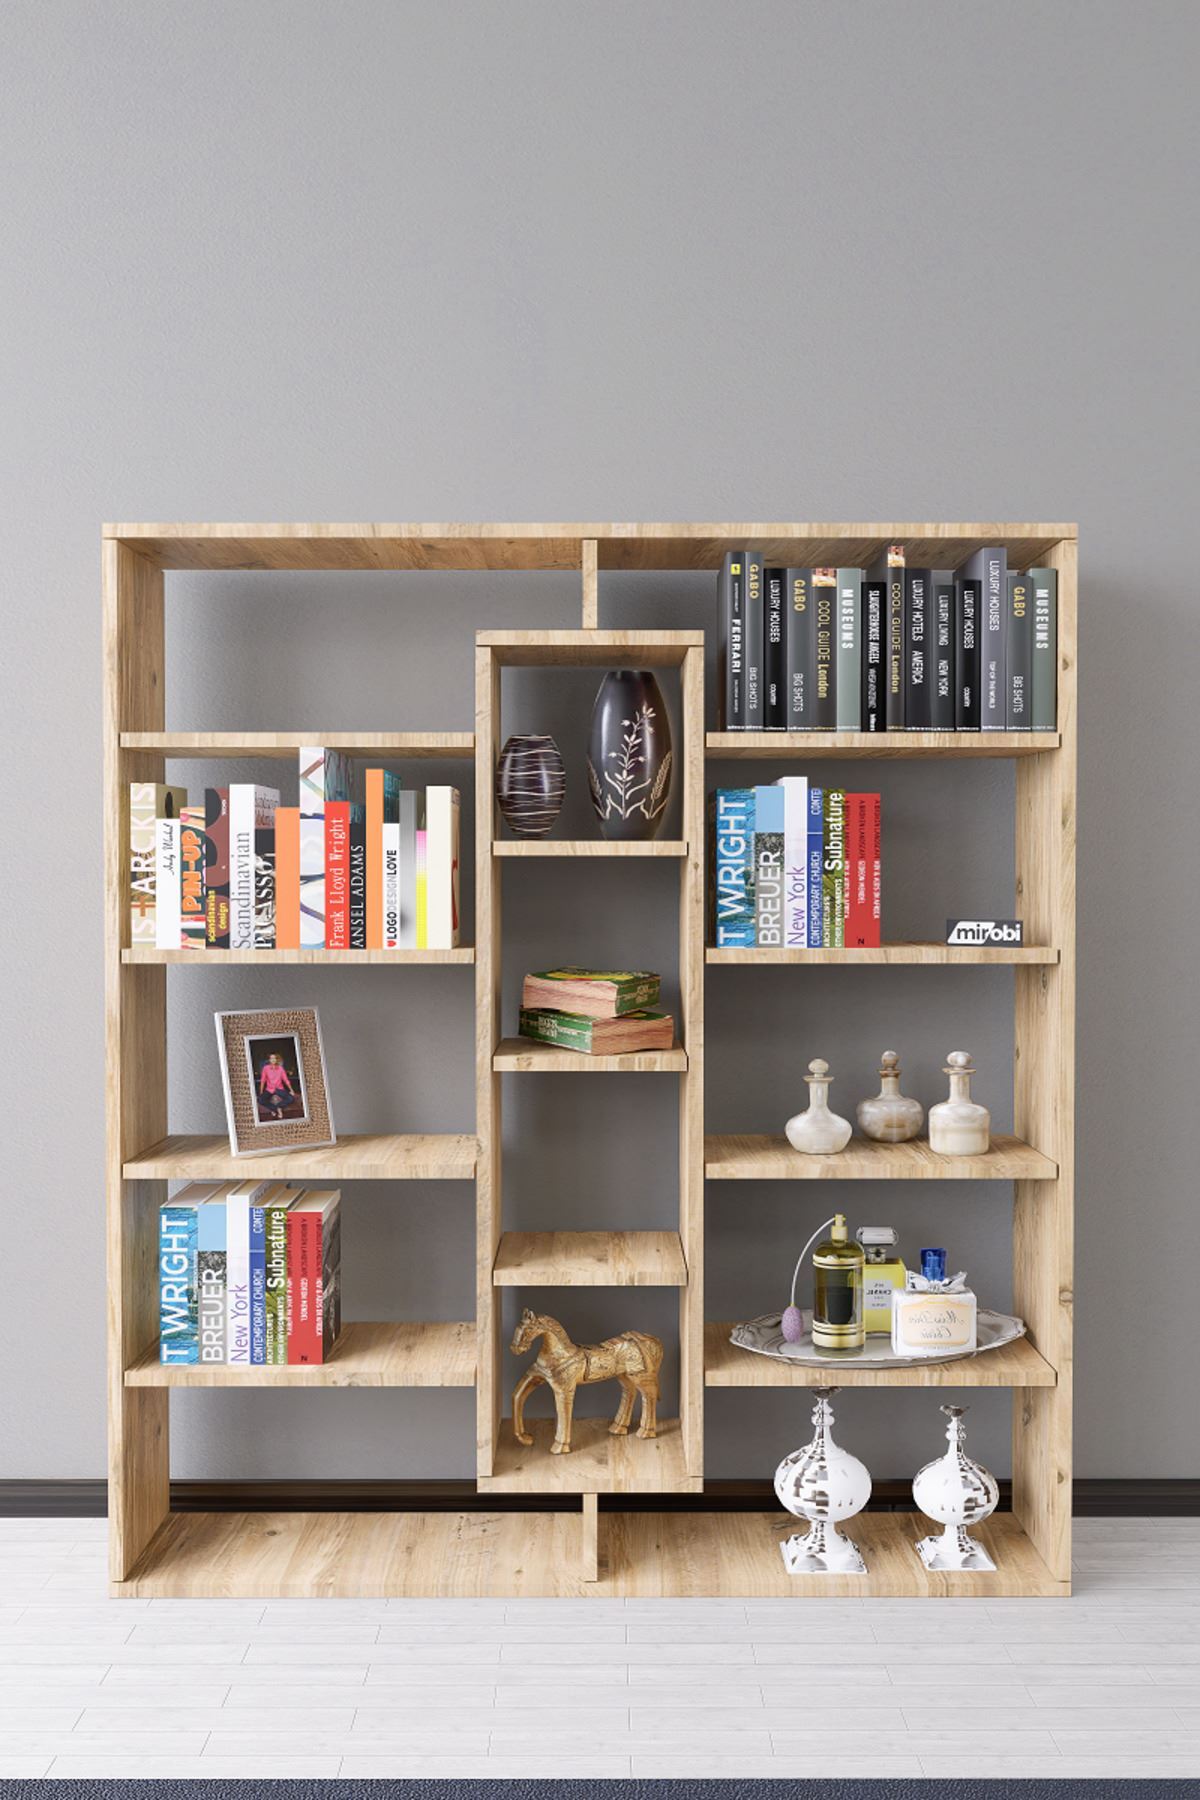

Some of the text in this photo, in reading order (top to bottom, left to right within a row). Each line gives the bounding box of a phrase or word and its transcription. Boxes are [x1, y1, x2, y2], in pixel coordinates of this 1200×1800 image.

[750, 564, 759, 599] GABO
[770, 580, 780, 643] LUXURY HOUSES
[794, 579, 806, 612] GABO
[912, 580, 923, 641] LUXURY HOTELS
[990, 560, 1000, 631] LUXURY HOUSES
[1014, 586, 1025, 617] GABO
[732, 619, 742, 673] FERRARI
[818, 600, 830, 699] COOL GUIDE London
[842, 589, 854, 649] MUSEUMS
[891, 583, 900, 693] COOL GUIDE London
[939, 595, 948, 646] LUXURY LIVING
[964, 590, 974, 649] LUXURY HOUSES
[1036, 589, 1048, 649] MUSEUMS
[750, 667, 758, 710] BIG SHOTS
[793, 673, 803, 712] BIG SHOTS
[912, 651, 923, 684] AMERICA
[939, 660, 948, 697] NEW YORK
[1013, 676, 1023, 713] BIG SHOTS
[719, 796, 746, 918] WRIGHT
[825, 793, 842, 870] Subnature
[181, 830, 202, 912] PIN-UP
[231, 832, 250, 949] Scandinavian
[330, 817, 346, 948] Frank Lloyd Wright
[351, 845, 364, 947] ANSEL ADAMS
[759, 851, 780, 944] BREUER
[811, 851, 820, 945] CONTEMPORARY CHURCH
[207, 890, 216, 942] scandinavian
[218, 902, 228, 930] design
[787, 866, 805, 944] New York
[957, 923, 1021, 941] mirobi
[162, 1215, 188, 1335] WRIGHT
[267, 1211, 284, 1288] Subnature
[202, 1268, 224, 1362] BREUER
[229, 1284, 248, 1362] New York
[253, 1269, 263, 1362] CONTEMPORARY CHURCH
